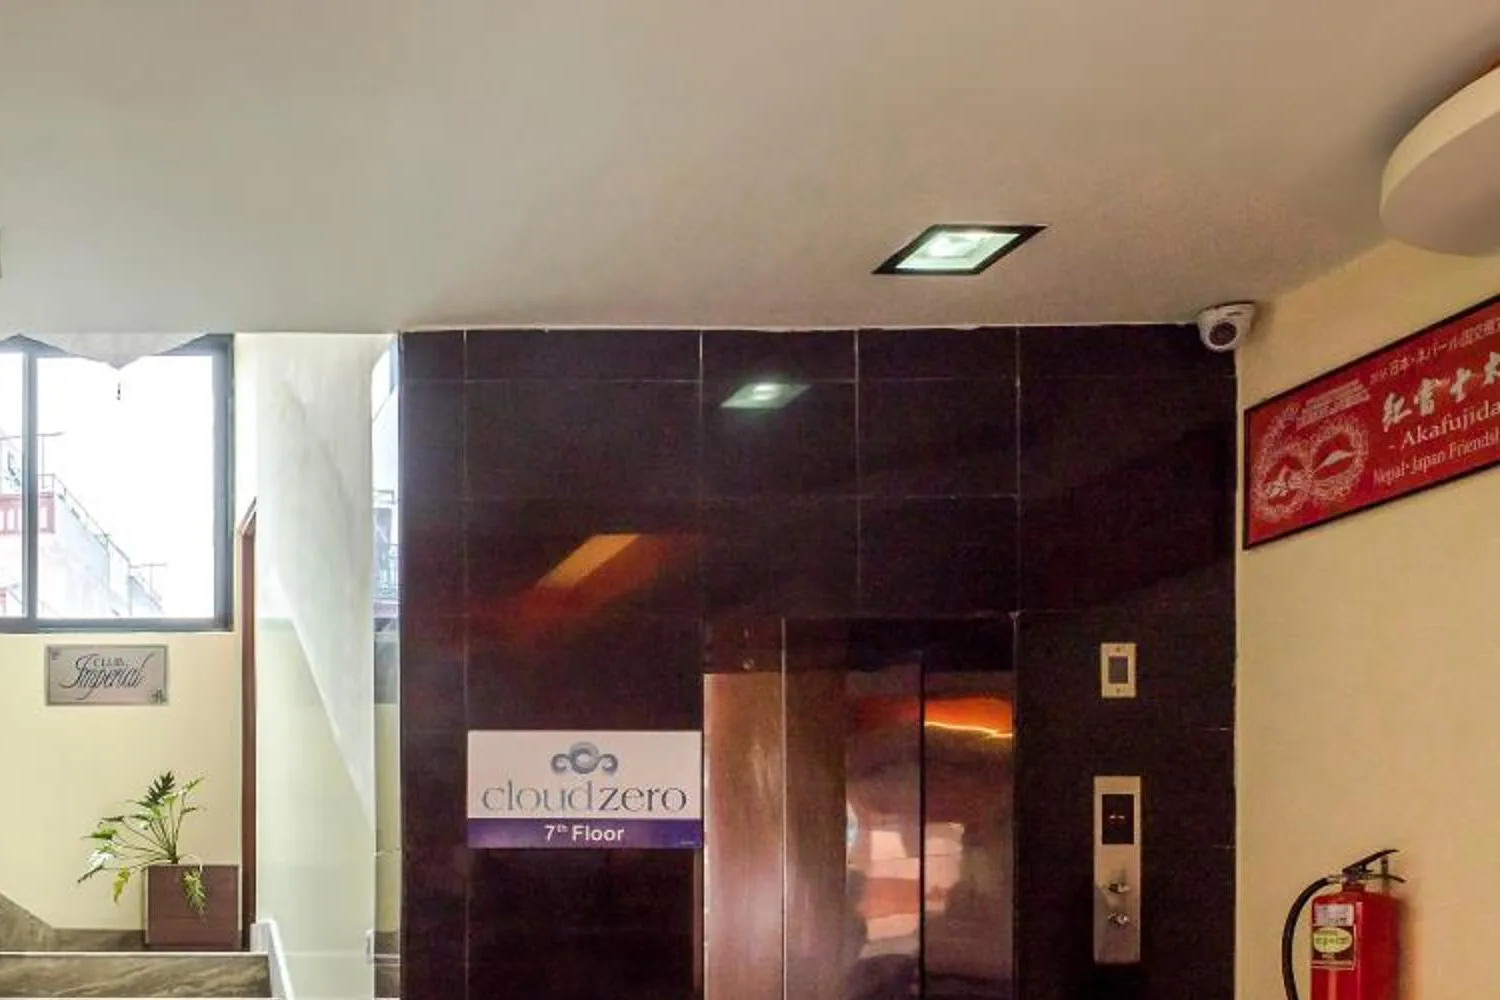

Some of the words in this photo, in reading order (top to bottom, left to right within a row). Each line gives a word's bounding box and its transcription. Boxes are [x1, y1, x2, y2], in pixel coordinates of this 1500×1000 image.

[58, 653, 155, 701] Imperial
[481, 779, 688, 813] cloudzero
[572, 825, 625, 842] Floor
